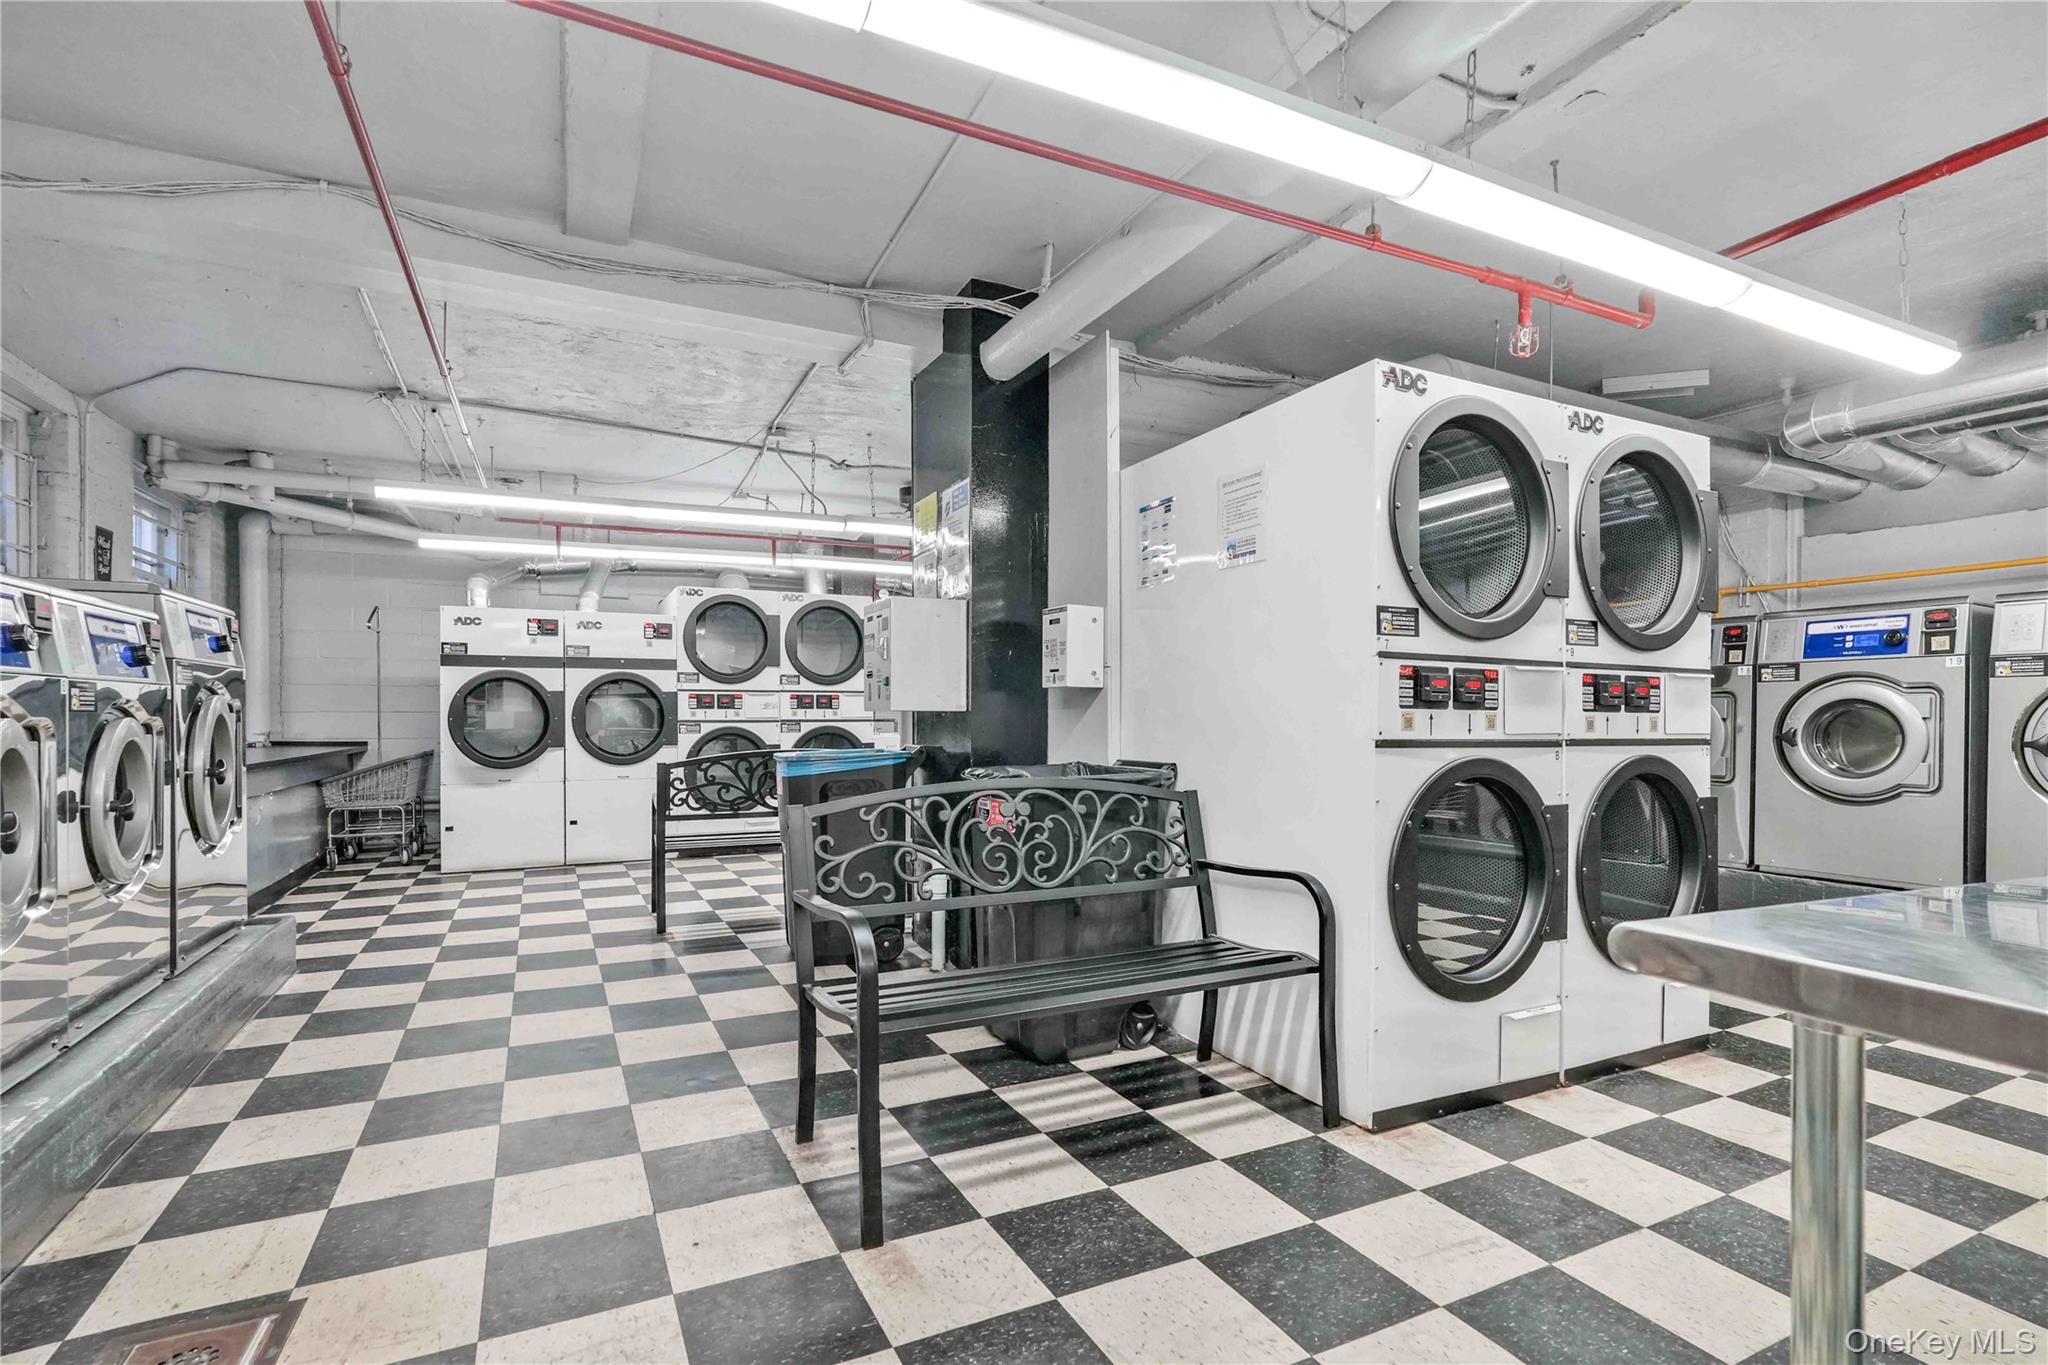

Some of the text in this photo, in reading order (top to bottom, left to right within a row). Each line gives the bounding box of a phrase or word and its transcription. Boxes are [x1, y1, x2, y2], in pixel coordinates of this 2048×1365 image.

[1381, 365, 1428, 397] ADC
[1567, 410, 1604, 436] ADC
[453, 616, 482, 626] ADC
[575, 620, 603, 630] ADC
[1570, 647, 1575, 656] 9
